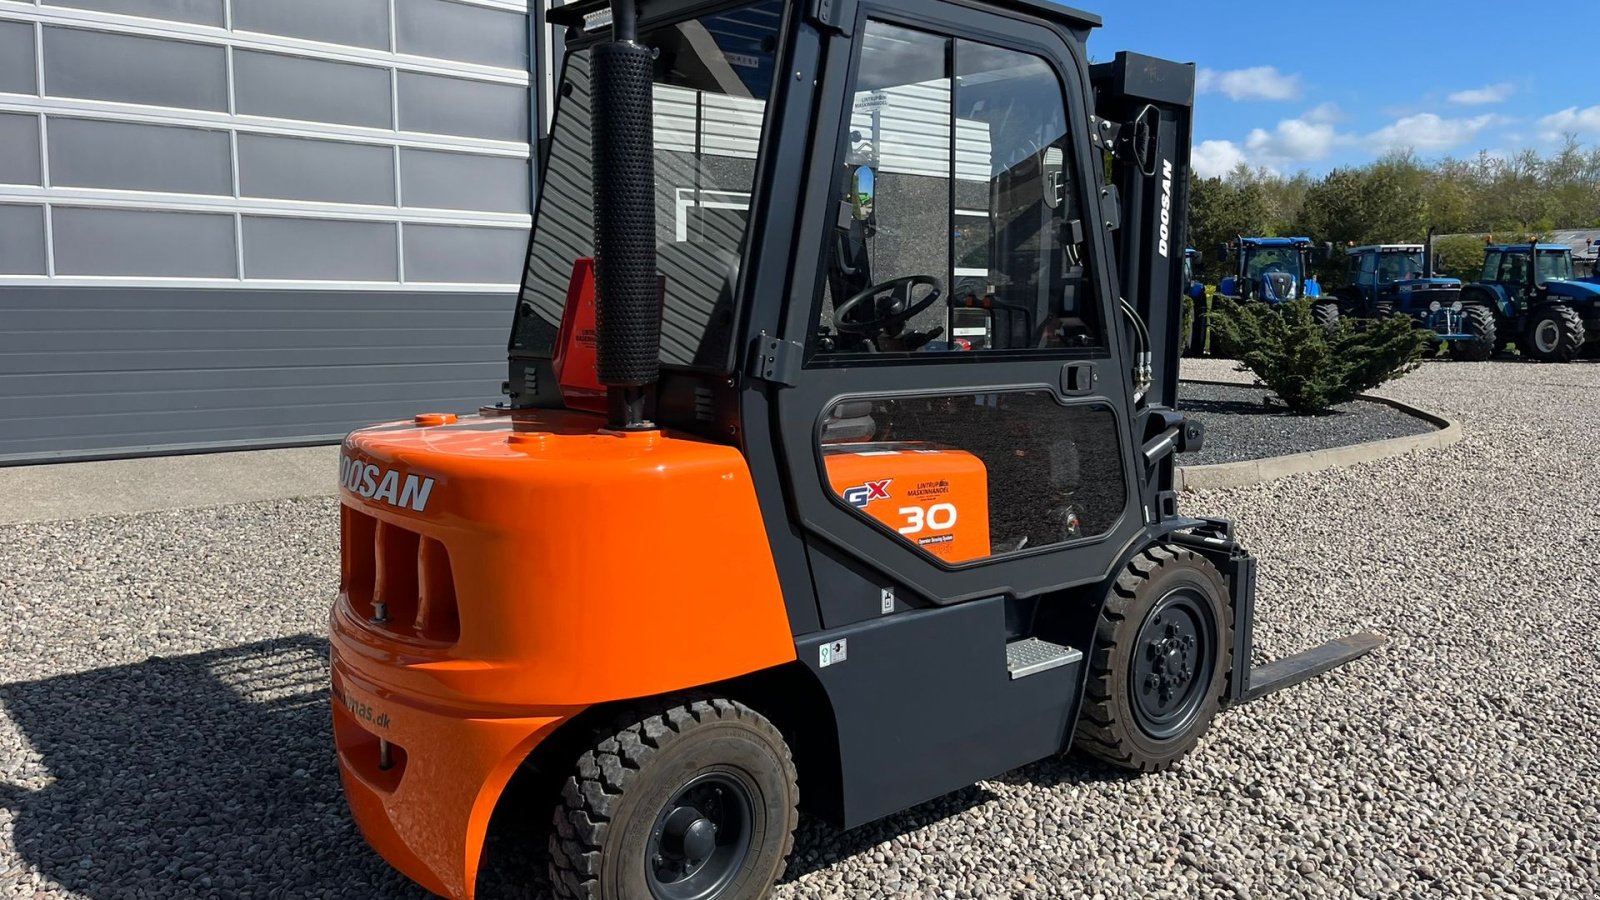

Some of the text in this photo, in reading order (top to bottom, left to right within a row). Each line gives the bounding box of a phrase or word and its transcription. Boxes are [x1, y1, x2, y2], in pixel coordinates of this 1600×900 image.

[1159, 159, 1172, 258] DOOSAN
[340, 455, 434, 512] OOSAN
[842, 479, 893, 509] GX
[907, 487, 949, 497] MASKINHANDEL
[917, 481, 939, 490] LINTRUP
[898, 502, 957, 535] 30
